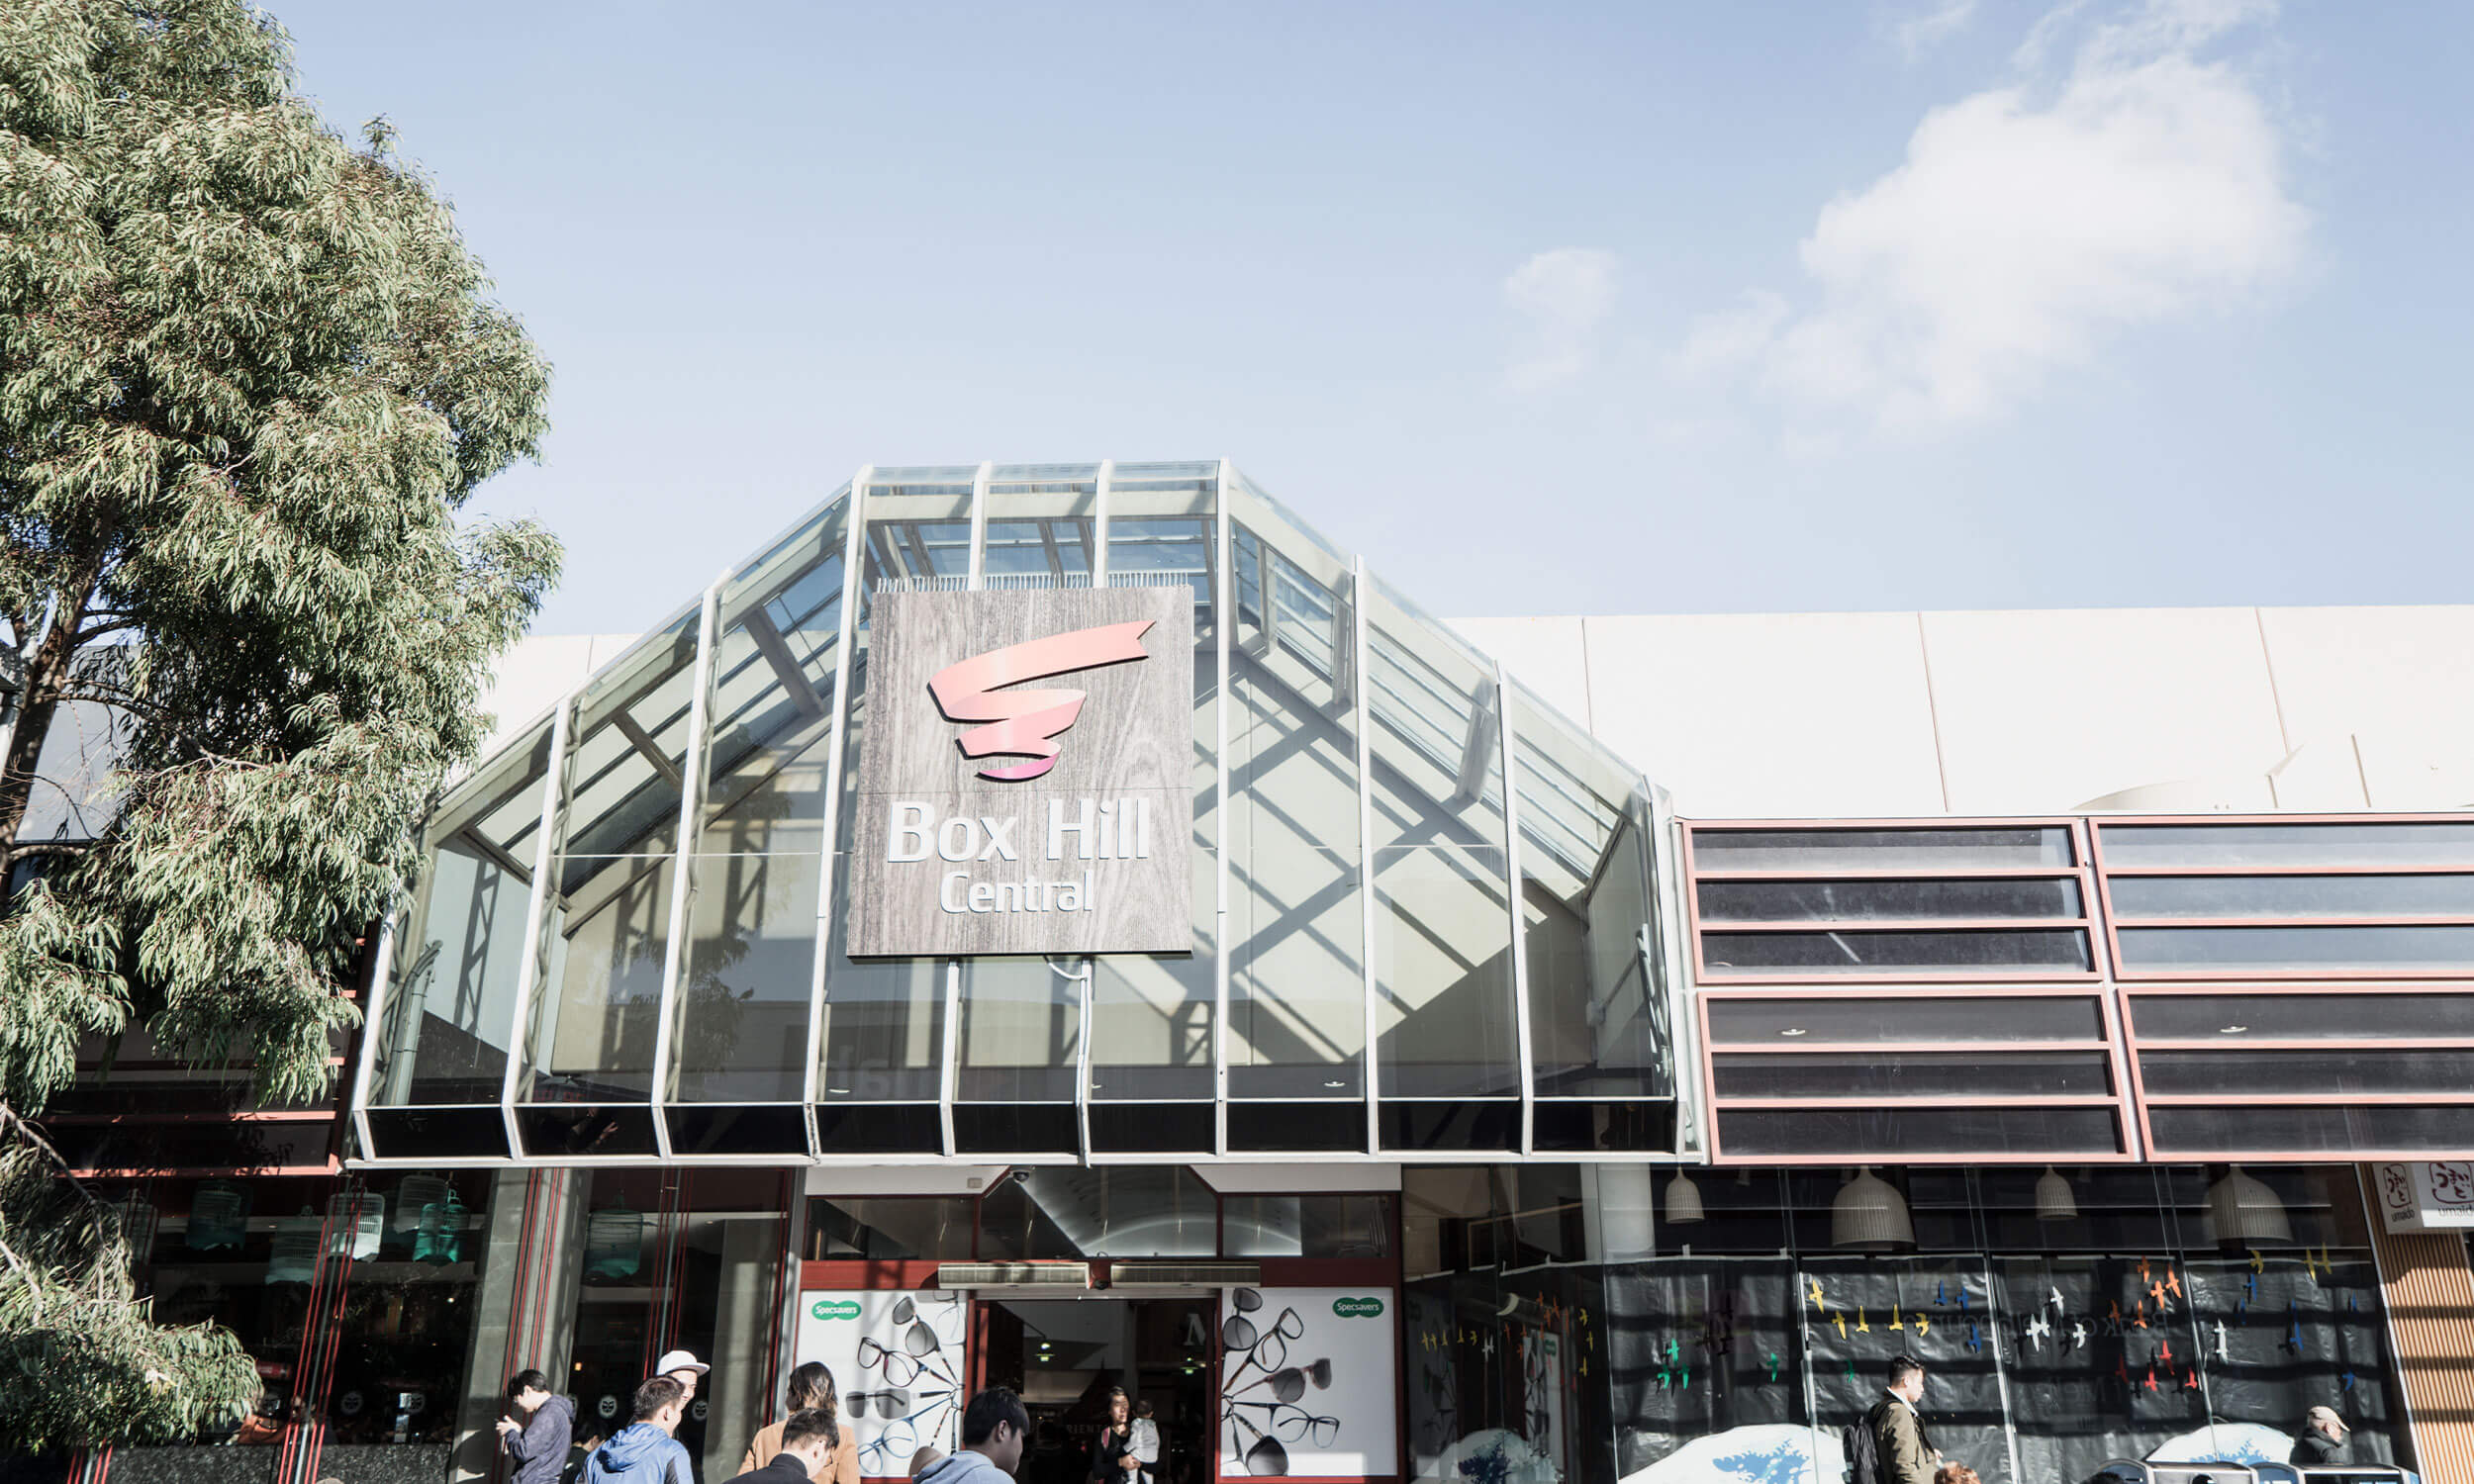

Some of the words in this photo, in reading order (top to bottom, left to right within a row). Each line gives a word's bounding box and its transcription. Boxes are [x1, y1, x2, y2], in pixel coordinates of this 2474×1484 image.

[888, 801, 1017, 863] Box
[1047, 797, 1149, 860] Hill
[940, 869, 1094, 913] Central
[2391, 1206, 2415, 1222] umaido
[815, 1305, 858, 1316] Specsavers
[1337, 1302, 1380, 1313] Specsavers
